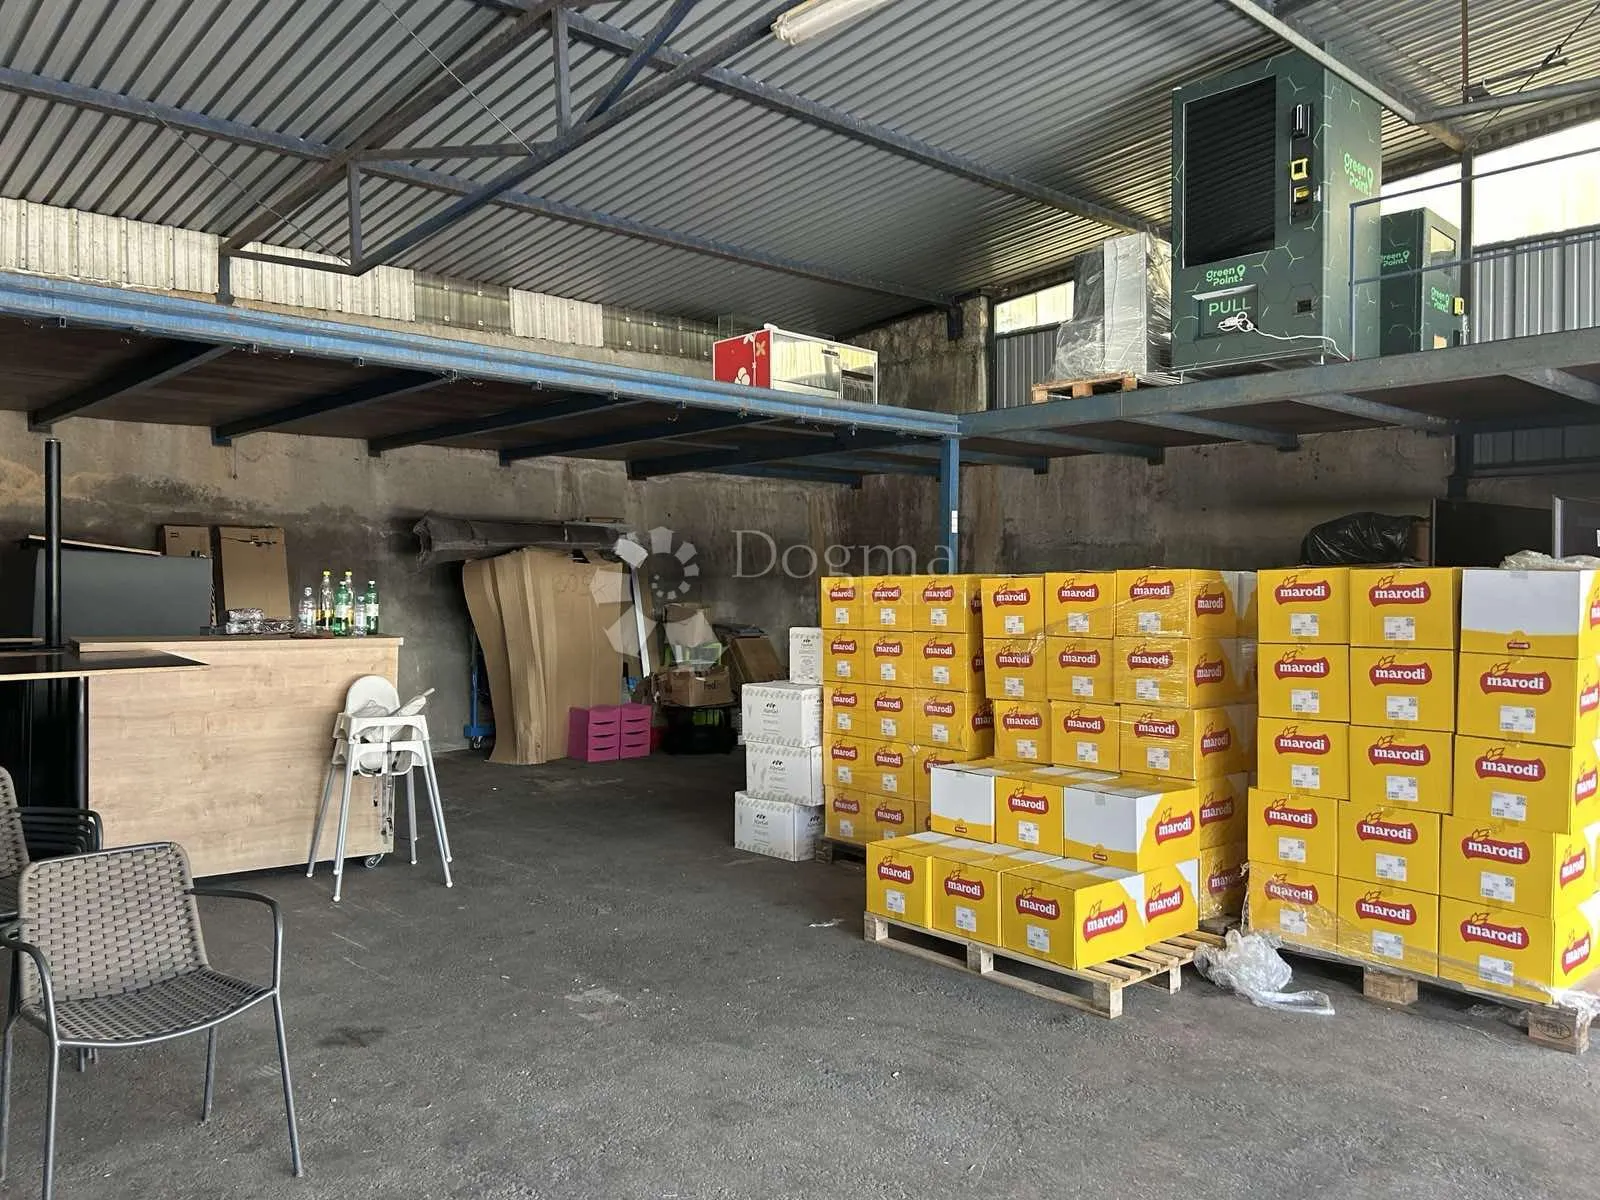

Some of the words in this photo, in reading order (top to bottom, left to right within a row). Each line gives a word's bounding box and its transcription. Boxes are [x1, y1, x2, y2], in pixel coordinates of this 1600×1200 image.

[1344, 153, 1366, 175] green
[1206, 267, 1235, 281] green
[1209, 297, 1251, 316] PULL
[875, 588, 898, 597] marodi
[926, 588, 951, 597] marodi
[997, 592, 1026, 601] marodi
[1062, 586, 1095, 597] marodi
[1134, 584, 1170, 596] marodi
[1280, 585, 1325, 597] marodi
[1375, 587, 1425, 599] marodi
[1198, 597, 1222, 609] marodi
[833, 642, 854, 651] marodi
[877, 643, 899, 653] marodi
[926, 645, 952, 654] marodi
[1000, 653, 1029, 663] marodi
[1063, 653, 1096, 663] marodi
[1132, 653, 1169, 665] marodi
[1197, 665, 1222, 678] marodi
[1280, 662, 1324, 673] marodi
[1376, 667, 1425, 680] marodi
[1487, 675, 1544, 689] marodi
[834, 694, 854, 703] marodi
[877, 700, 900, 708] marodi
[926, 703, 952, 713] marodi
[1007, 716, 1038, 726] marodi
[1068, 718, 1100, 729] marodi
[1139, 722, 1175, 735] marodi
[1204, 734, 1228, 749] marodi
[1280, 737, 1324, 750] marodi
[877, 754, 900, 765] marodi
[1375, 748, 1424, 761] marodi
[1481, 760, 1539, 777] marodi
[1012, 797, 1044, 811] marodi
[878, 808, 901, 822] marodi
[1269, 811, 1313, 825] marodi
[1159, 818, 1191, 836] marodi
[1363, 824, 1412, 840] marodi
[1468, 841, 1523, 860] marodi
[881, 865, 910, 881] marodi
[948, 880, 980, 897] marodi
[1270, 885, 1313, 901] marodi
[1020, 898, 1055, 916] marodi
[1149, 893, 1180, 914] marodi
[1362, 903, 1410, 921] marodi
[1087, 910, 1123, 933] marodi
[1467, 925, 1522, 945] marodi
